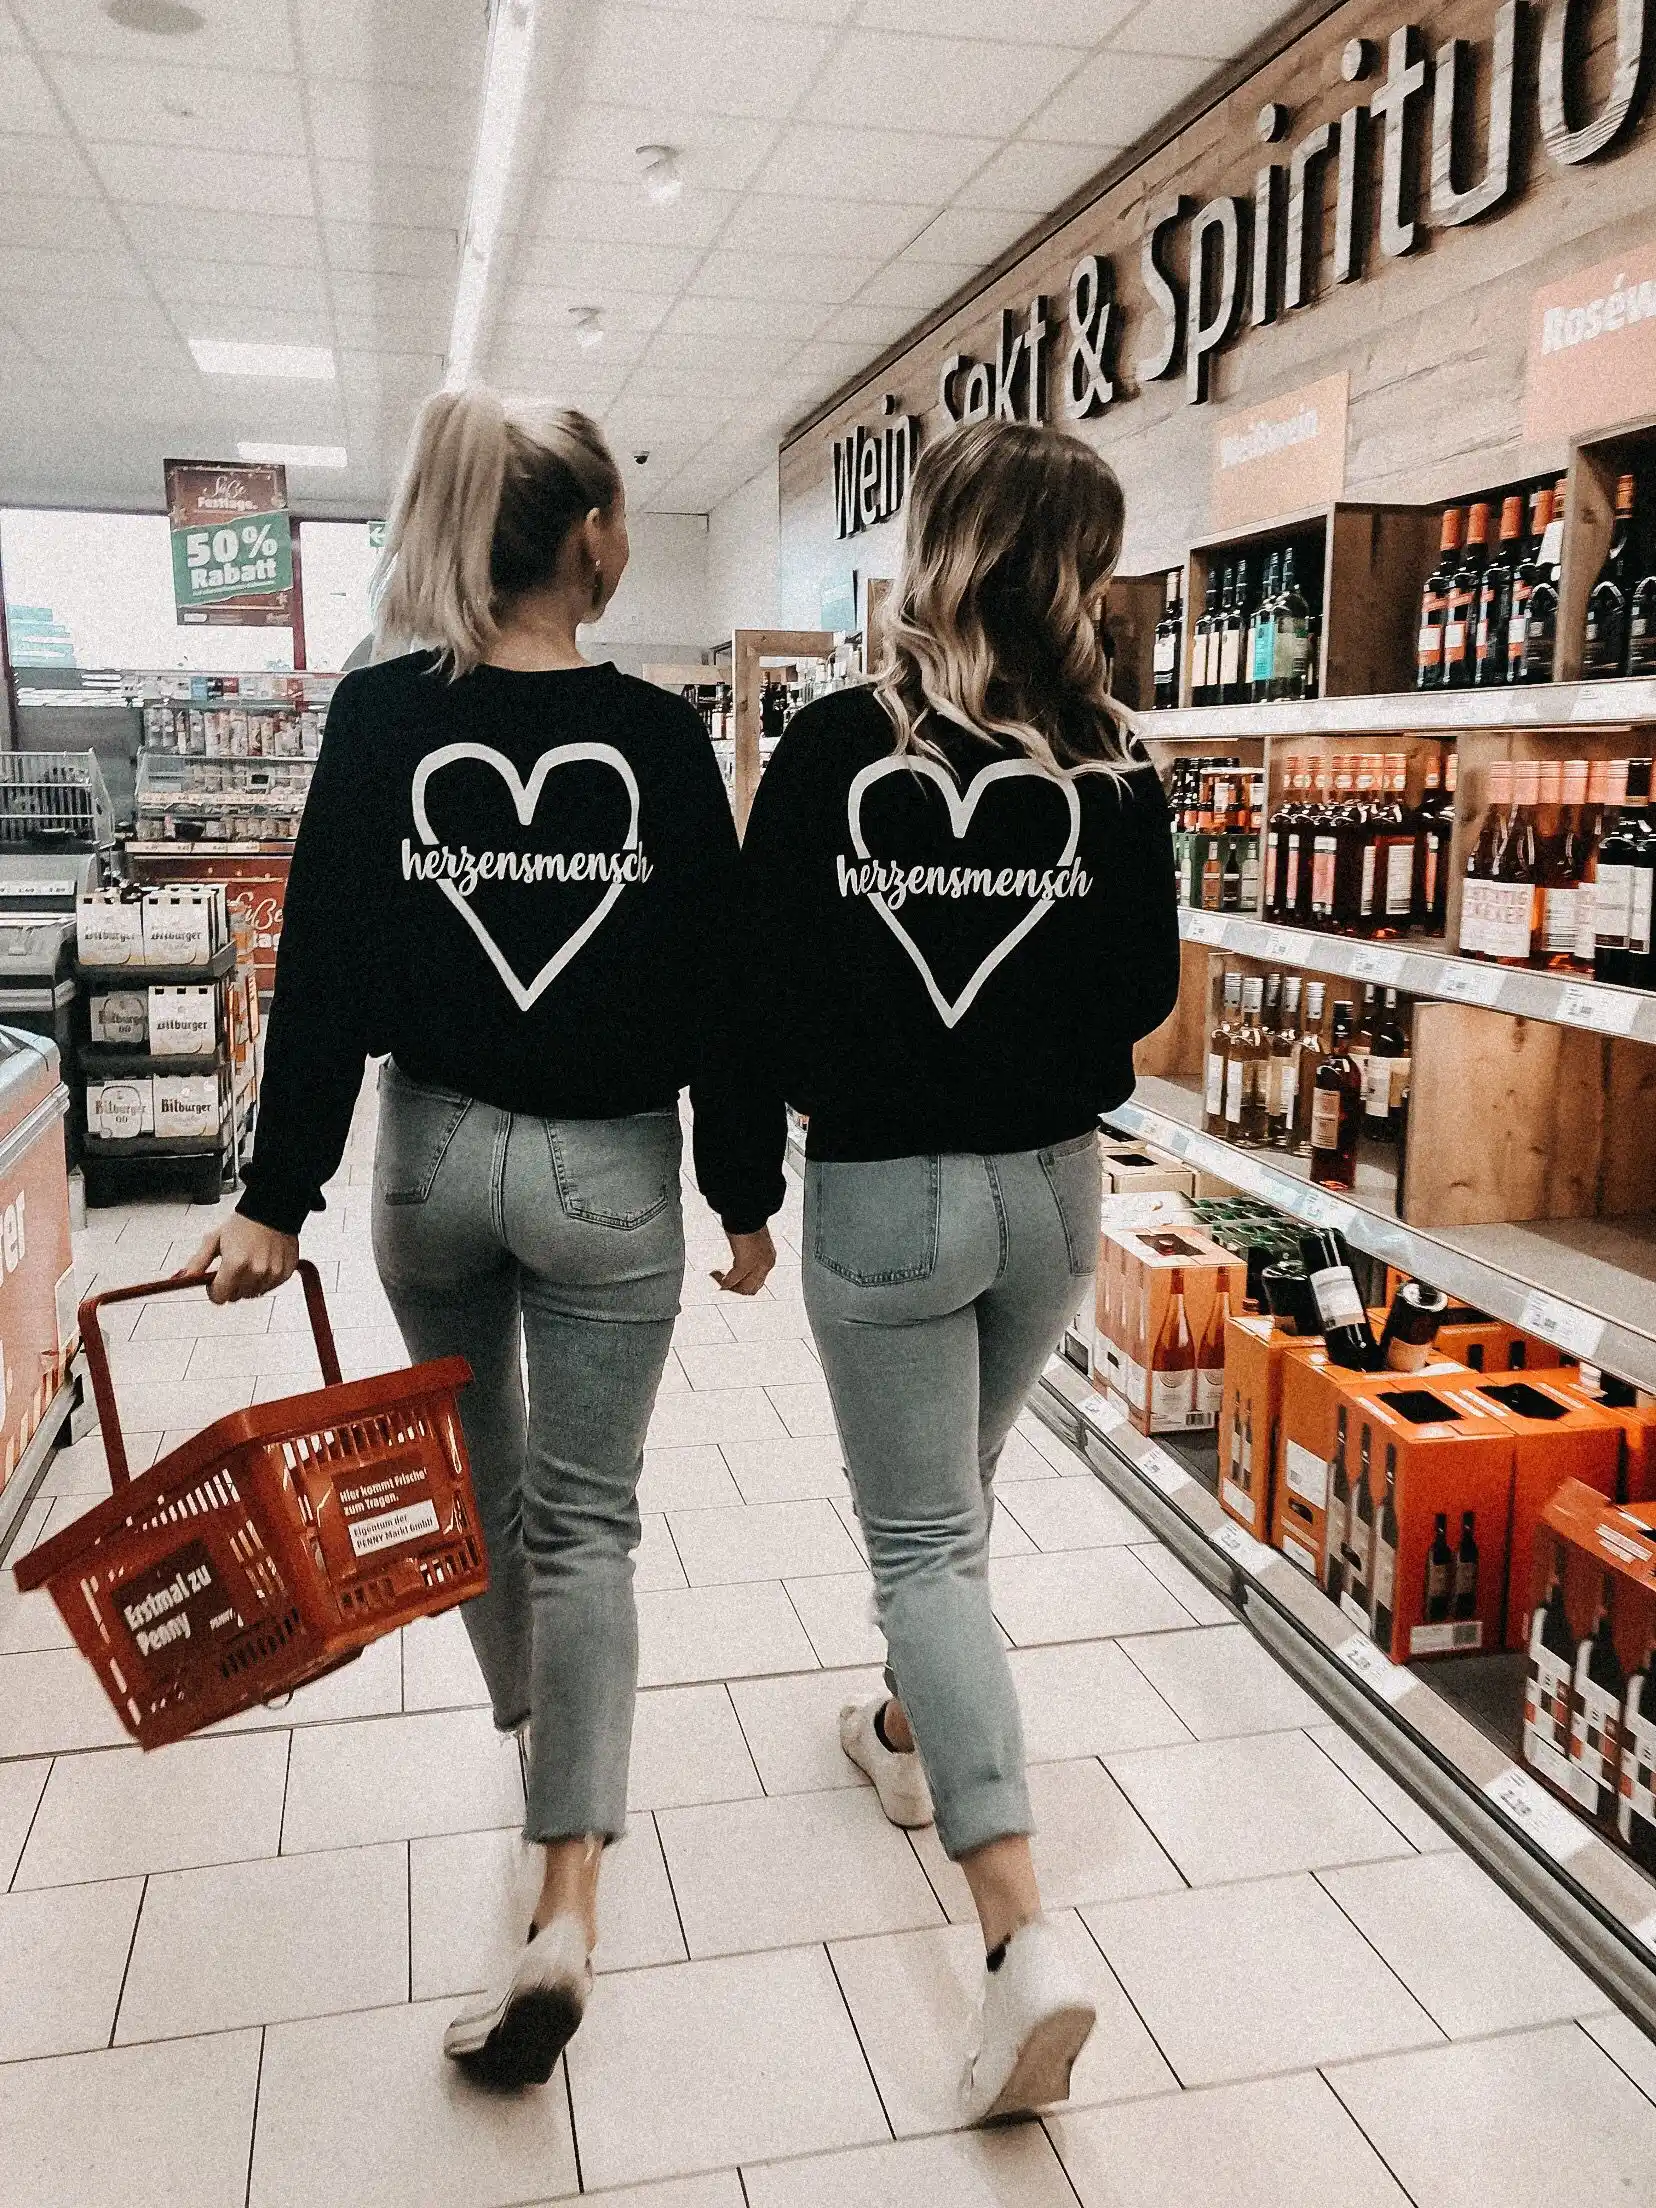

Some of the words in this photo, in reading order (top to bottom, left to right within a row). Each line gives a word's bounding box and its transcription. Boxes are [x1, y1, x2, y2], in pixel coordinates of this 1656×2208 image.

[833, 394, 914, 541] Wein
[1067, 254, 1113, 420] &
[186, 523, 279, 568] 50%
[190, 557, 278, 590] Rabatt
[401, 838, 654, 897] herzensmensch
[836, 854, 1094, 911] herzensmensch
[161, 1098, 211, 1115] Bitburger
[343, 1503, 365, 1516] zum
[365, 1492, 399, 1508] Tragen.
[360, 1478, 395, 1497] kommt
[353, 1520, 393, 1537] Eigentum
[394, 1514, 408, 1526] der
[356, 1534, 383, 1549] PENNY
[385, 1526, 409, 1540] Markt
[123, 1572, 190, 1632] Erstmal
[187, 1564, 212, 1594] zu
[136, 1611, 191, 1657] Penny
